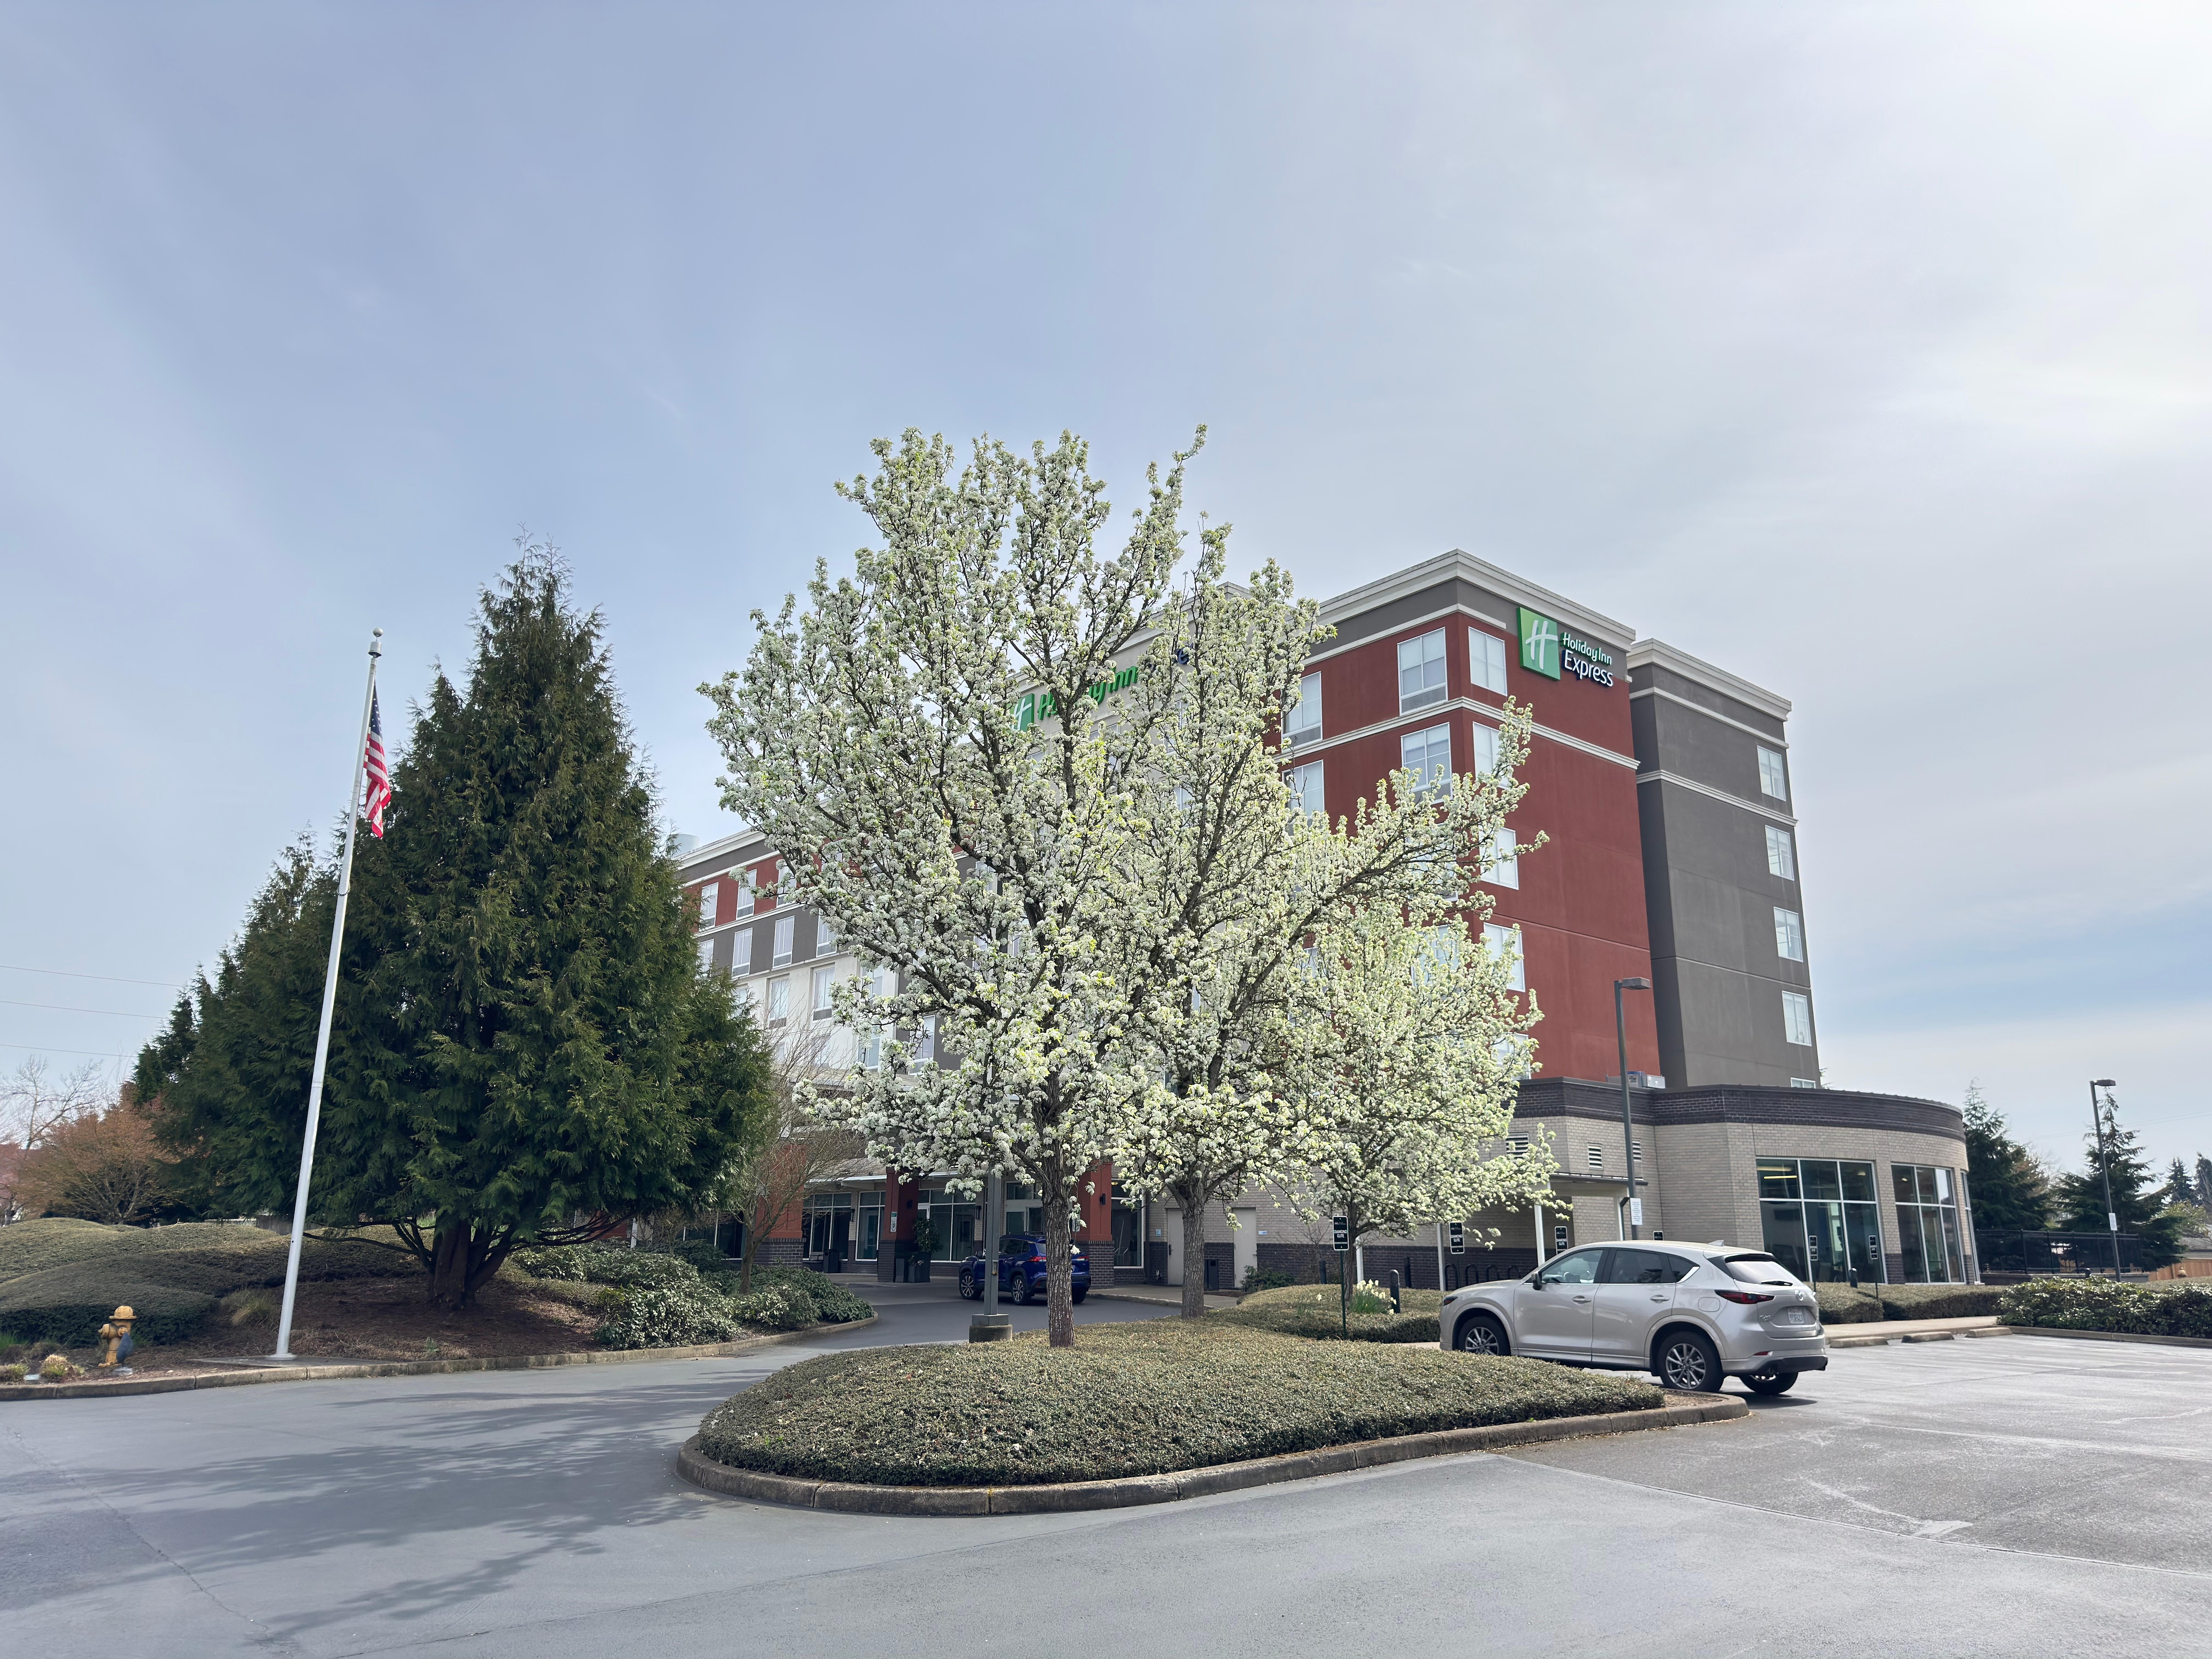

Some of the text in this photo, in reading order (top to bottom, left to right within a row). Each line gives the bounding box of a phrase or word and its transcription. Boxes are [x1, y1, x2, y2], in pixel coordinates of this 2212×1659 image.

[1525, 620, 1558, 670] H
[1563, 632, 1612, 665] Holiday Inn
[1564, 649, 1613, 687] Express
